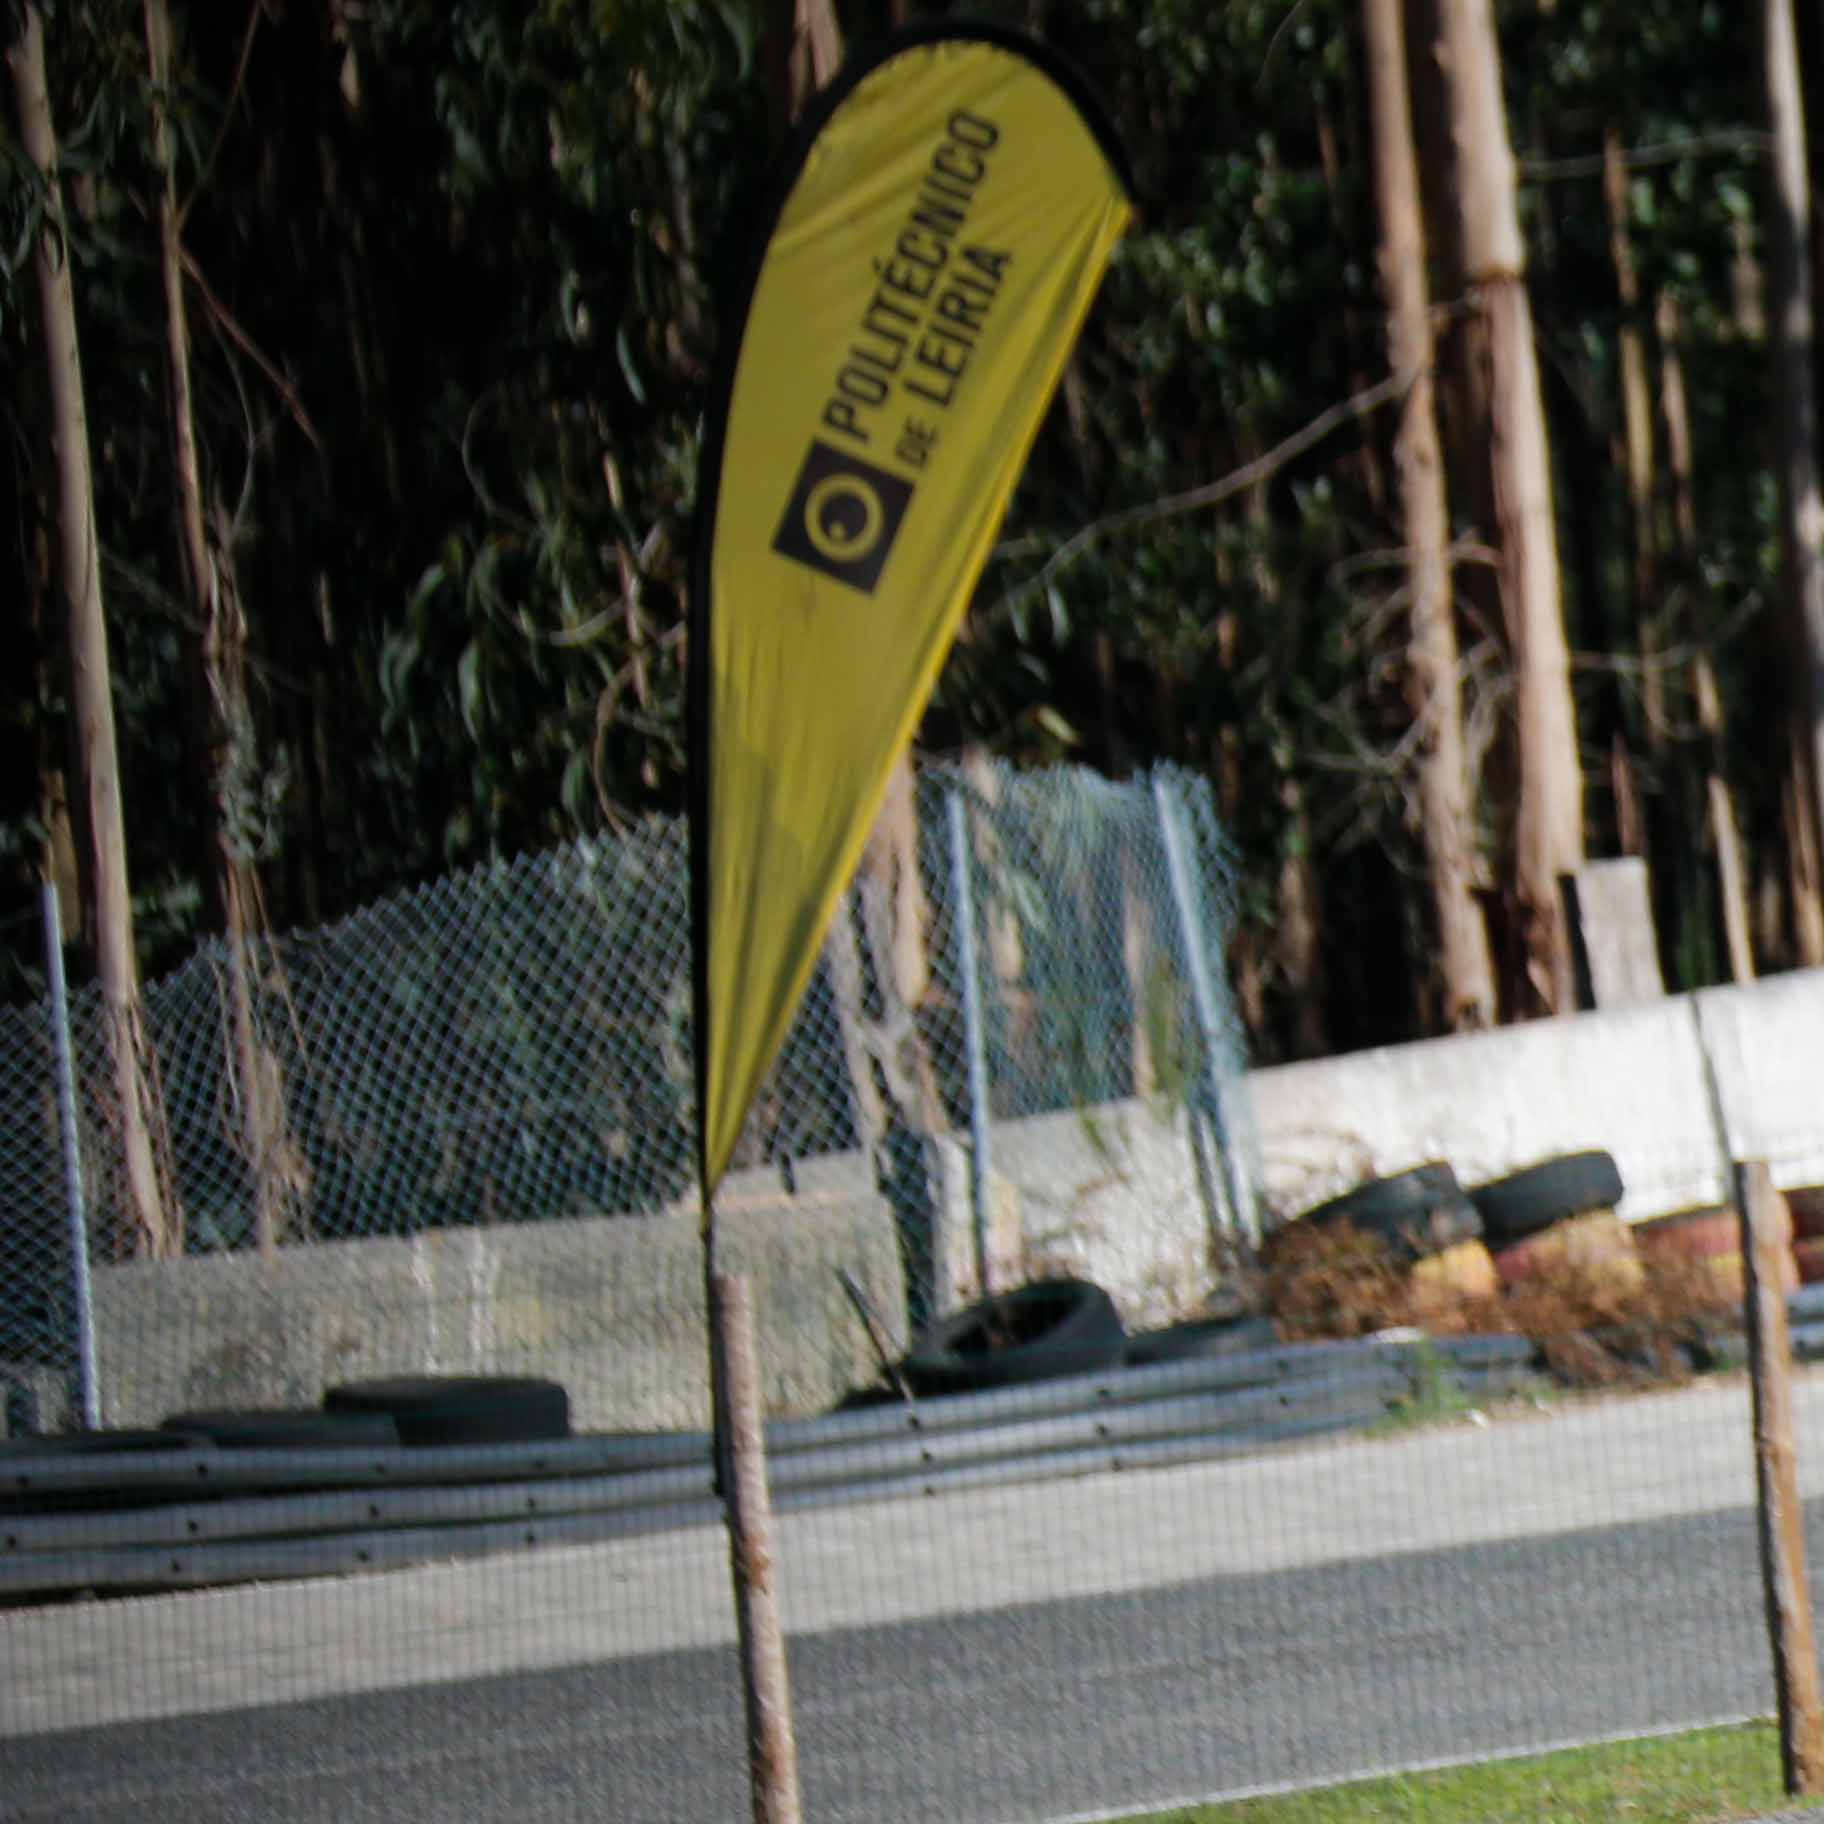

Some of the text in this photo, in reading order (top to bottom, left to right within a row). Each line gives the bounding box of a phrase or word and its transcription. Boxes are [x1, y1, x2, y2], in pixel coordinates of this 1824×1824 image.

[823, 110, 999, 441] POLITÉCNICO
[896, 246, 1011, 469] DE LEIRIA
